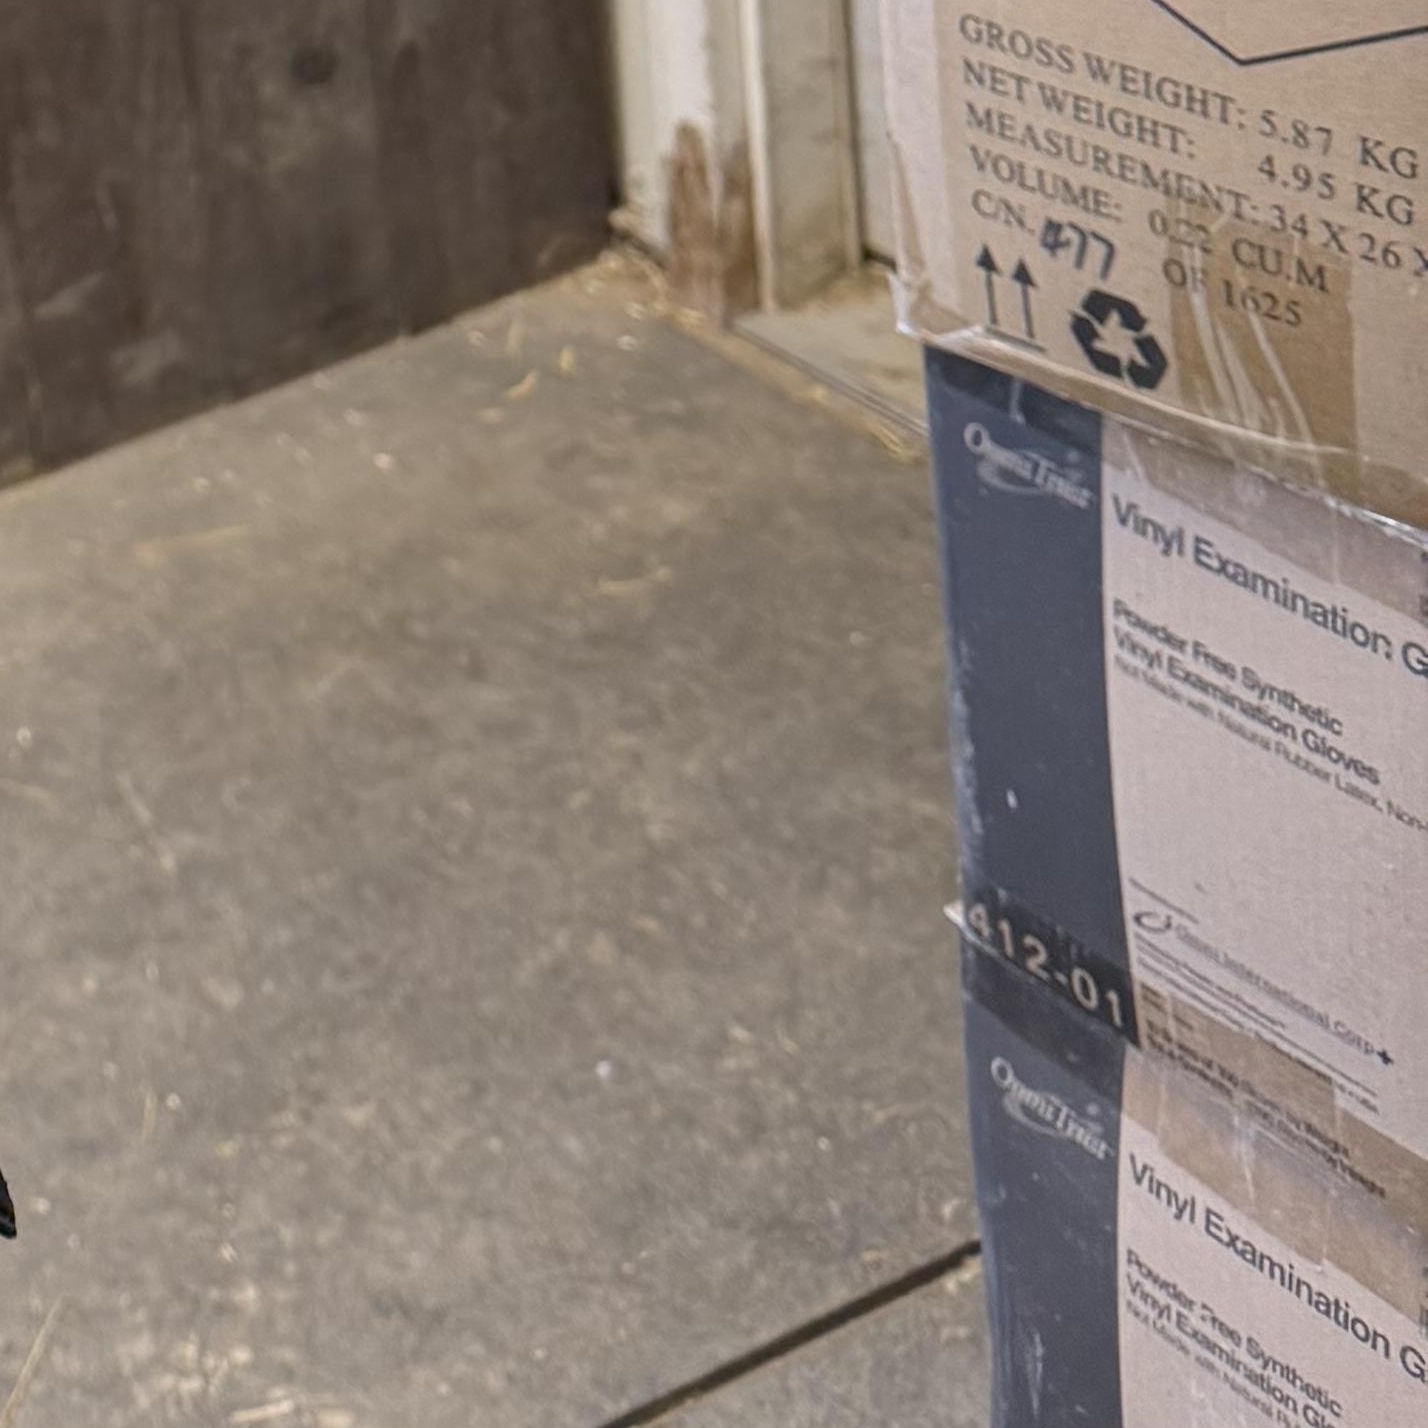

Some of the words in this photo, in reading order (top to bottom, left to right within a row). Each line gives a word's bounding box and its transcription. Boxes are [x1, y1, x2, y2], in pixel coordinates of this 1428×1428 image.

[959, 13, 1075, 75] GROSS
[1082, 50, 1247, 131] WEIGHT:
[1258, 109, 1333, 156] 5.87
[1358, 135, 1419, 180] KG
[962, 56, 1032, 103] NET
[1037, 81, 1196, 160] WEIGHT:
[1258, 154, 1336, 200] 4.95
[1354, 182, 1415, 226] KG
[965, 100, 1260, 225] MEASUREMENT:
[1270, 204, 1309, 239] 34
[1320, 219, 1349, 254] X
[1358, 232, 1402, 269] 26
[969, 144, 1123, 224] VOLUME:
[1232, 238, 1329, 294] CU.M
[1222, 278, 1302, 327] 1625
[1111, 494, 1185, 559] Vinyl
[1193, 536, 1393, 661] Examination
[1113, 598, 1188, 654] Powder
[1192, 639, 1237, 682] Free
[1241, 665, 1343, 737] Synthetic
[1113, 625, 1163, 669] Vinyl
[1166, 654, 1298, 741] Examination
[1301, 727, 1380, 787] Gloves
[1126, 1247, 1195, 1312] Powder
[1246, 1335, 1342, 1419] Synthetic
[1127, 1152, 1197, 1226] Vinyl
[1204, 1207, 1391, 1360] Examination
[1126, 1272, 1171, 1323] Vinyl
[1175, 1309, 1298, 1415] Examination
